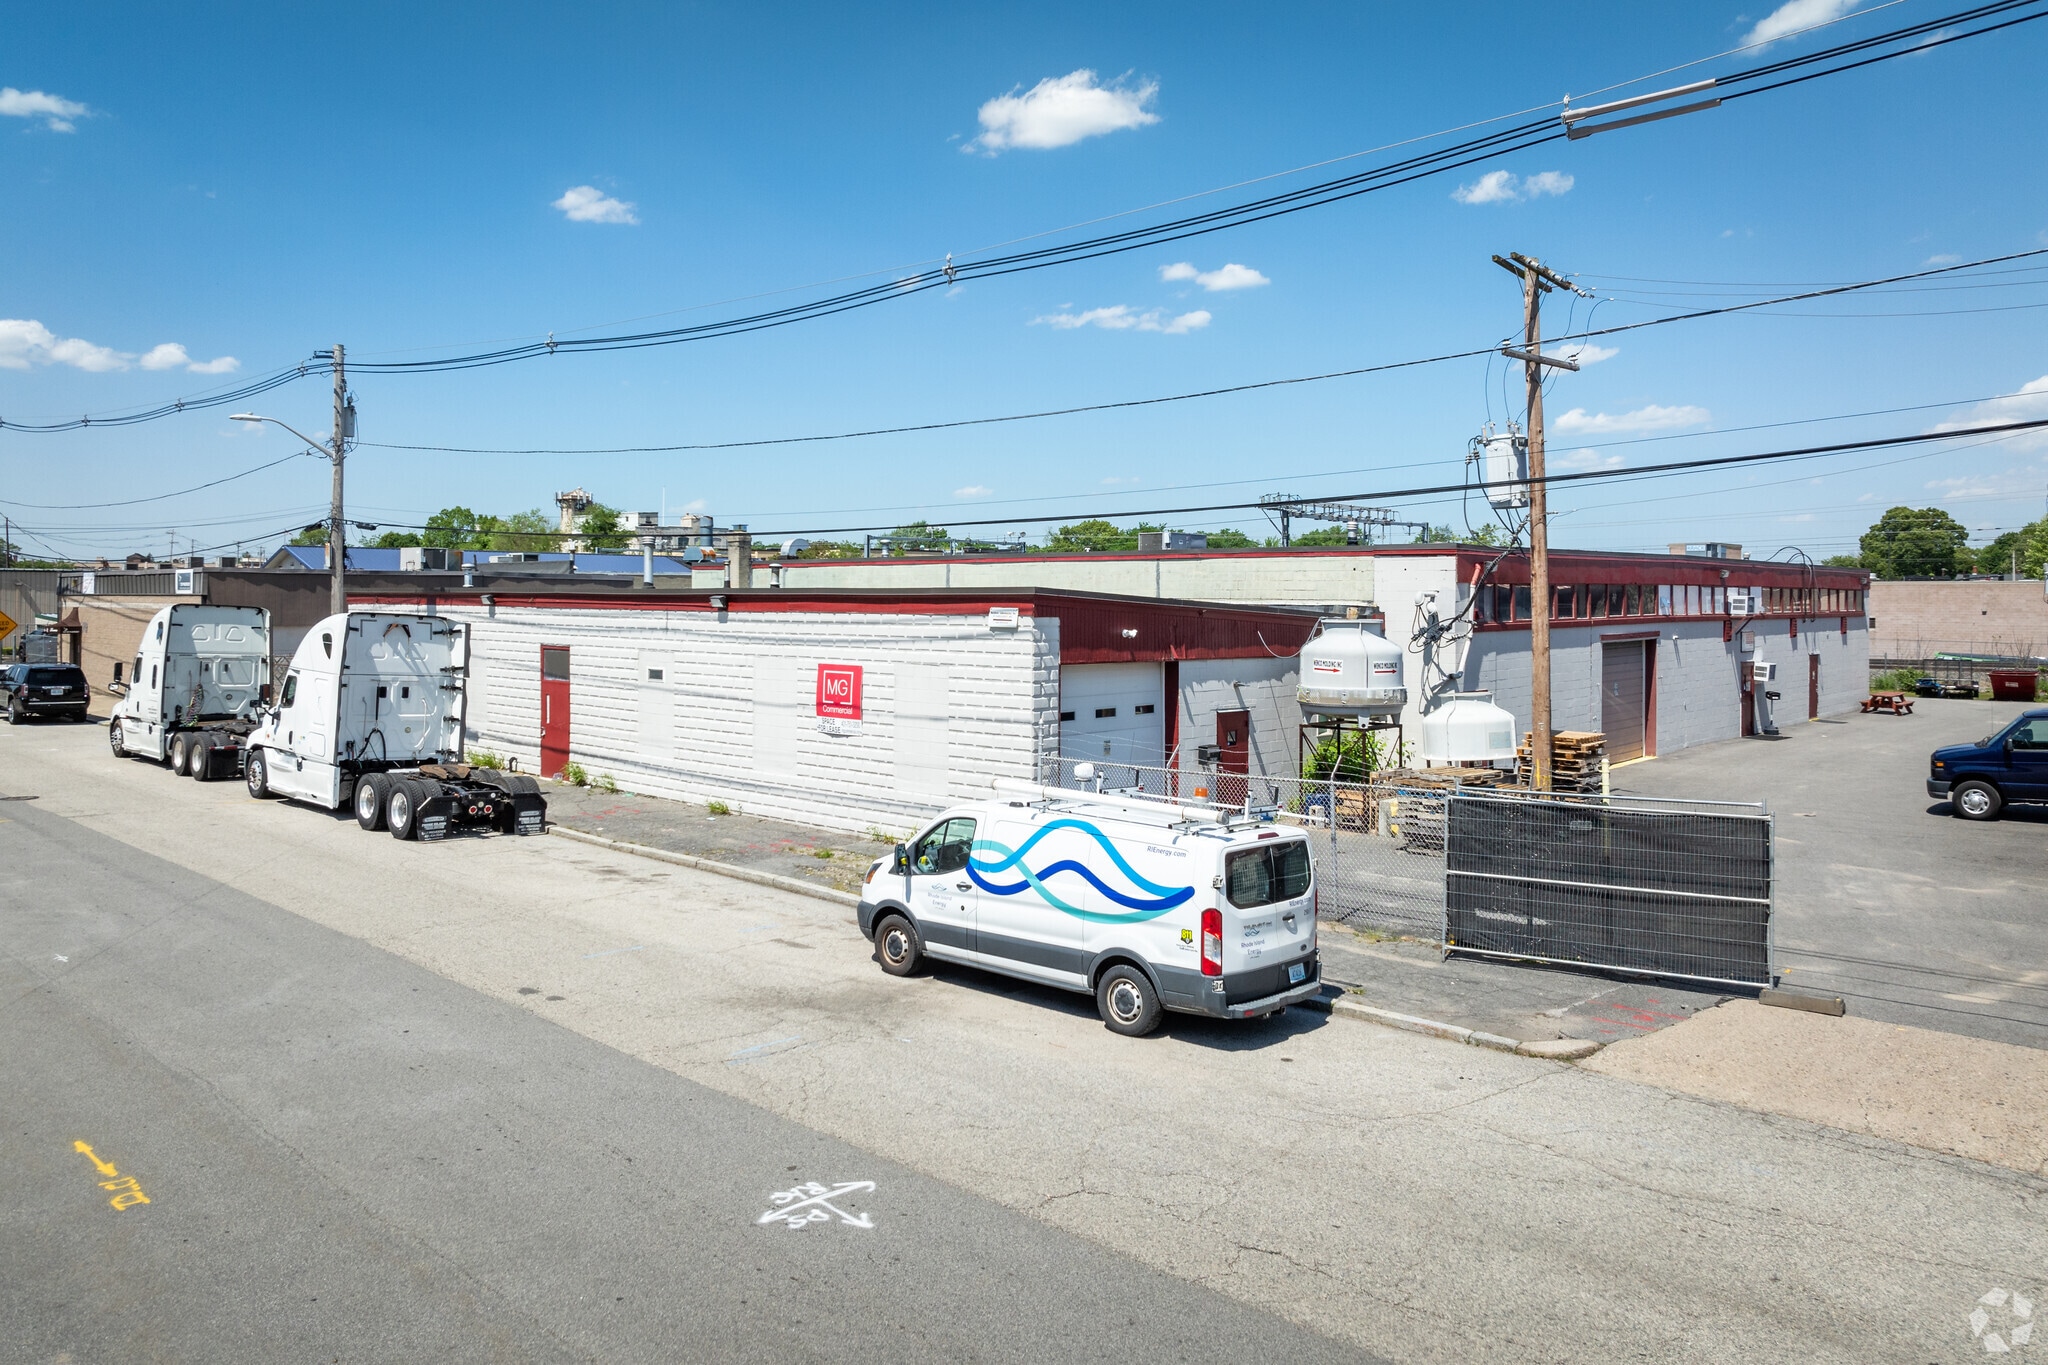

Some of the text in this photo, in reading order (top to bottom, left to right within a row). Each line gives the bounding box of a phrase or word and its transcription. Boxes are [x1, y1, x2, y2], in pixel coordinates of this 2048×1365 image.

[827, 678, 848, 696] MG
[822, 704, 853, 715] Commercial
[822, 717, 835, 725] SPACE
[827, 725, 840, 733] LEASE
[1147, 845, 1187, 858] RIEnergy.com
[1181, 929, 1193, 940] 811
